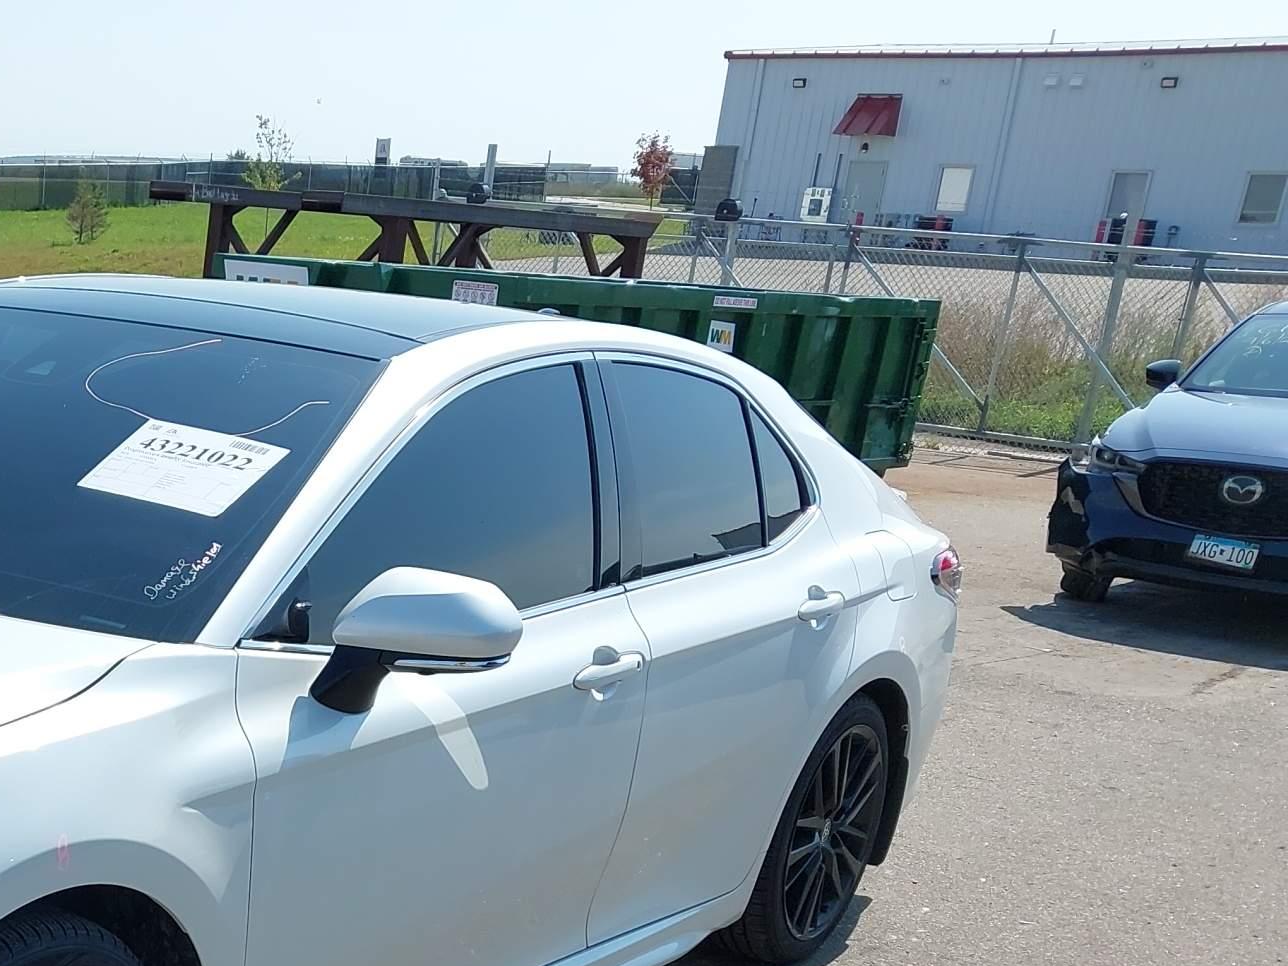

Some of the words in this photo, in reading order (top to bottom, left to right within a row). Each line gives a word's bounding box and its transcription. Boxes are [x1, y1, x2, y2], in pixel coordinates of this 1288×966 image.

[710, 328, 732, 345] WM
[140, 437, 253, 470] 43221022
[1192, 541, 1220, 559] JXG
[1226, 547, 1255, 566] 100
